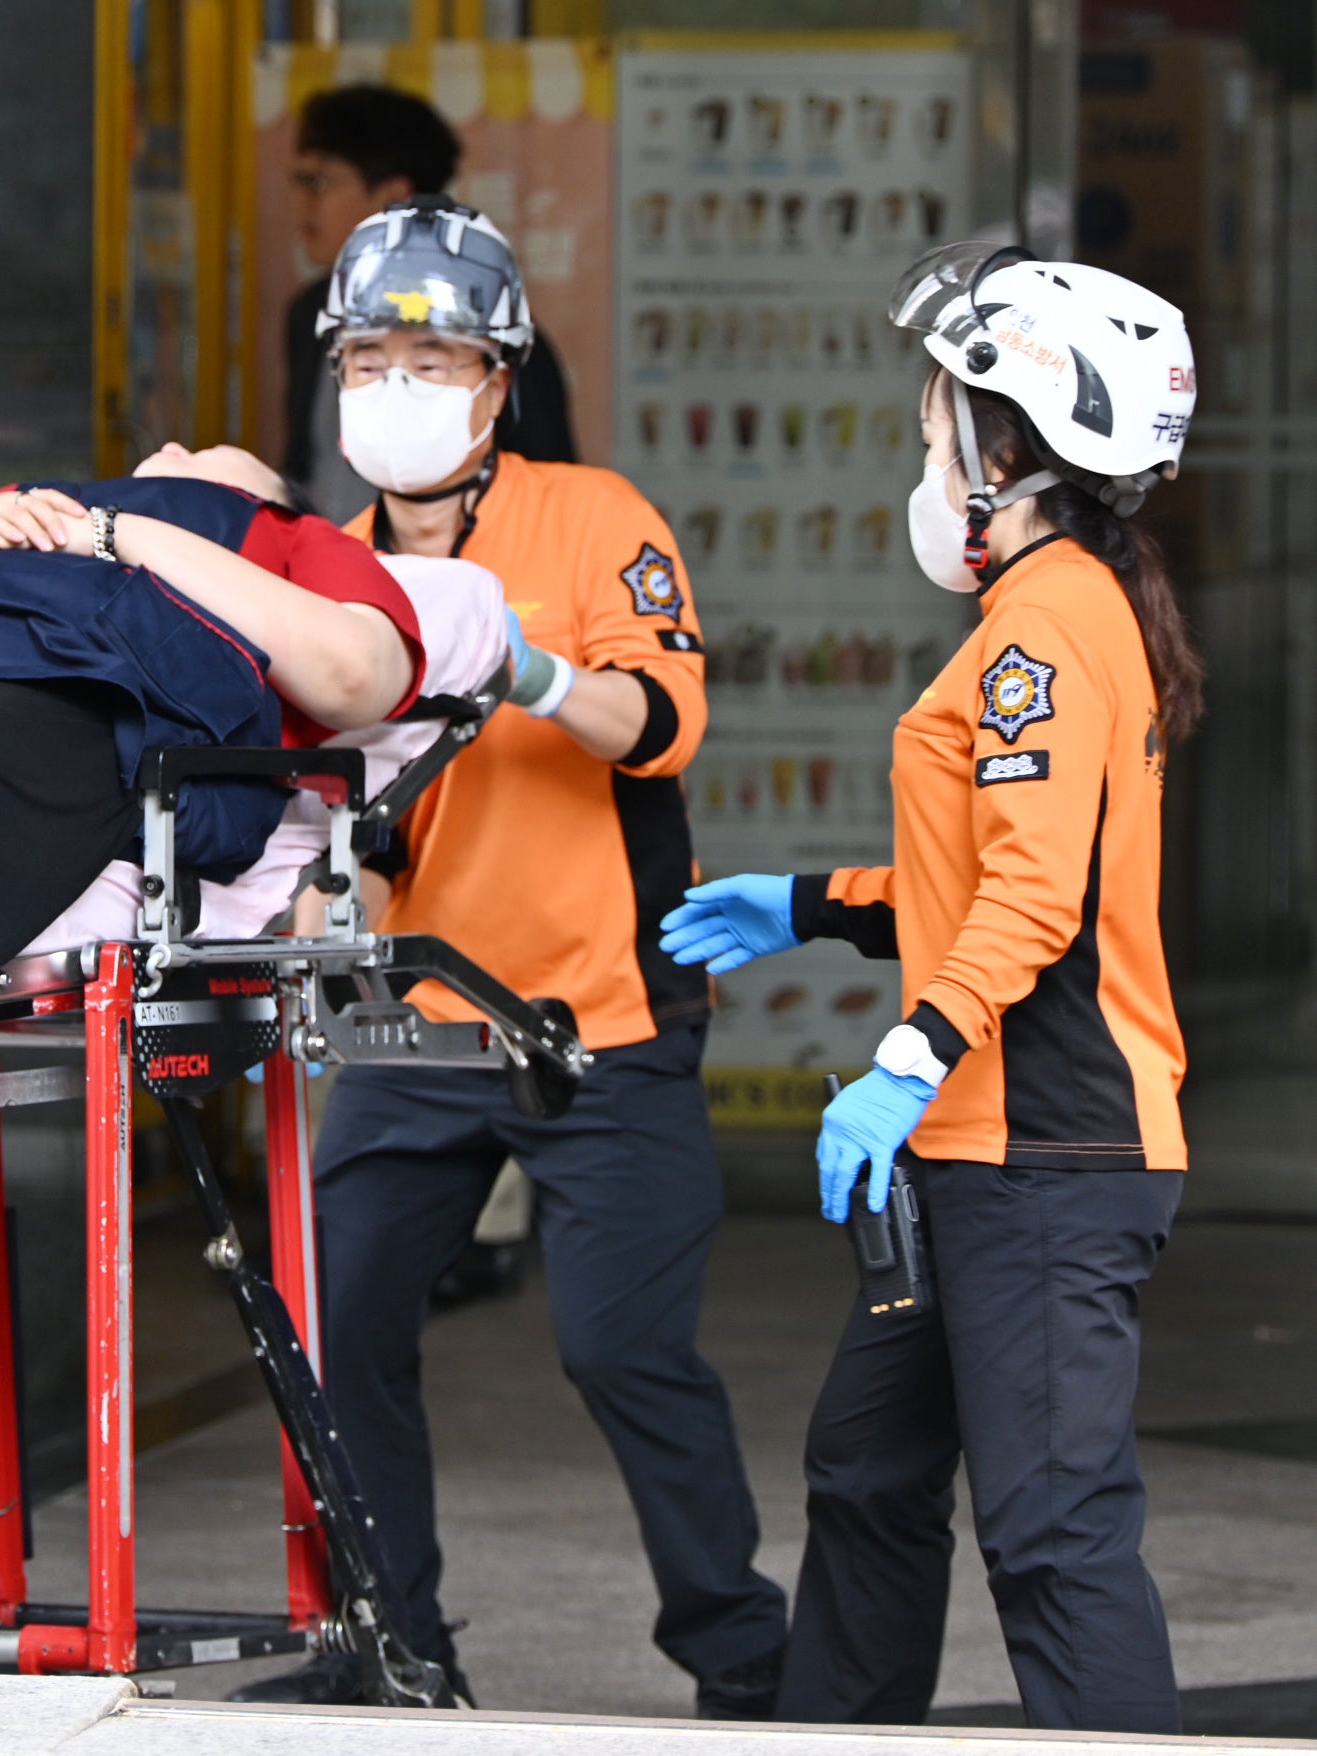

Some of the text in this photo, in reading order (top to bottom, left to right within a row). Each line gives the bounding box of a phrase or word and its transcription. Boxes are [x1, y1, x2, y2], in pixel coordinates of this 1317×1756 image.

[1009, 308, 1037, 333] 인천
[994, 328, 1069, 374] 남동소방서
[1152, 412, 1190, 443] 구급
[148, 1054, 210, 1079] AUTECH
